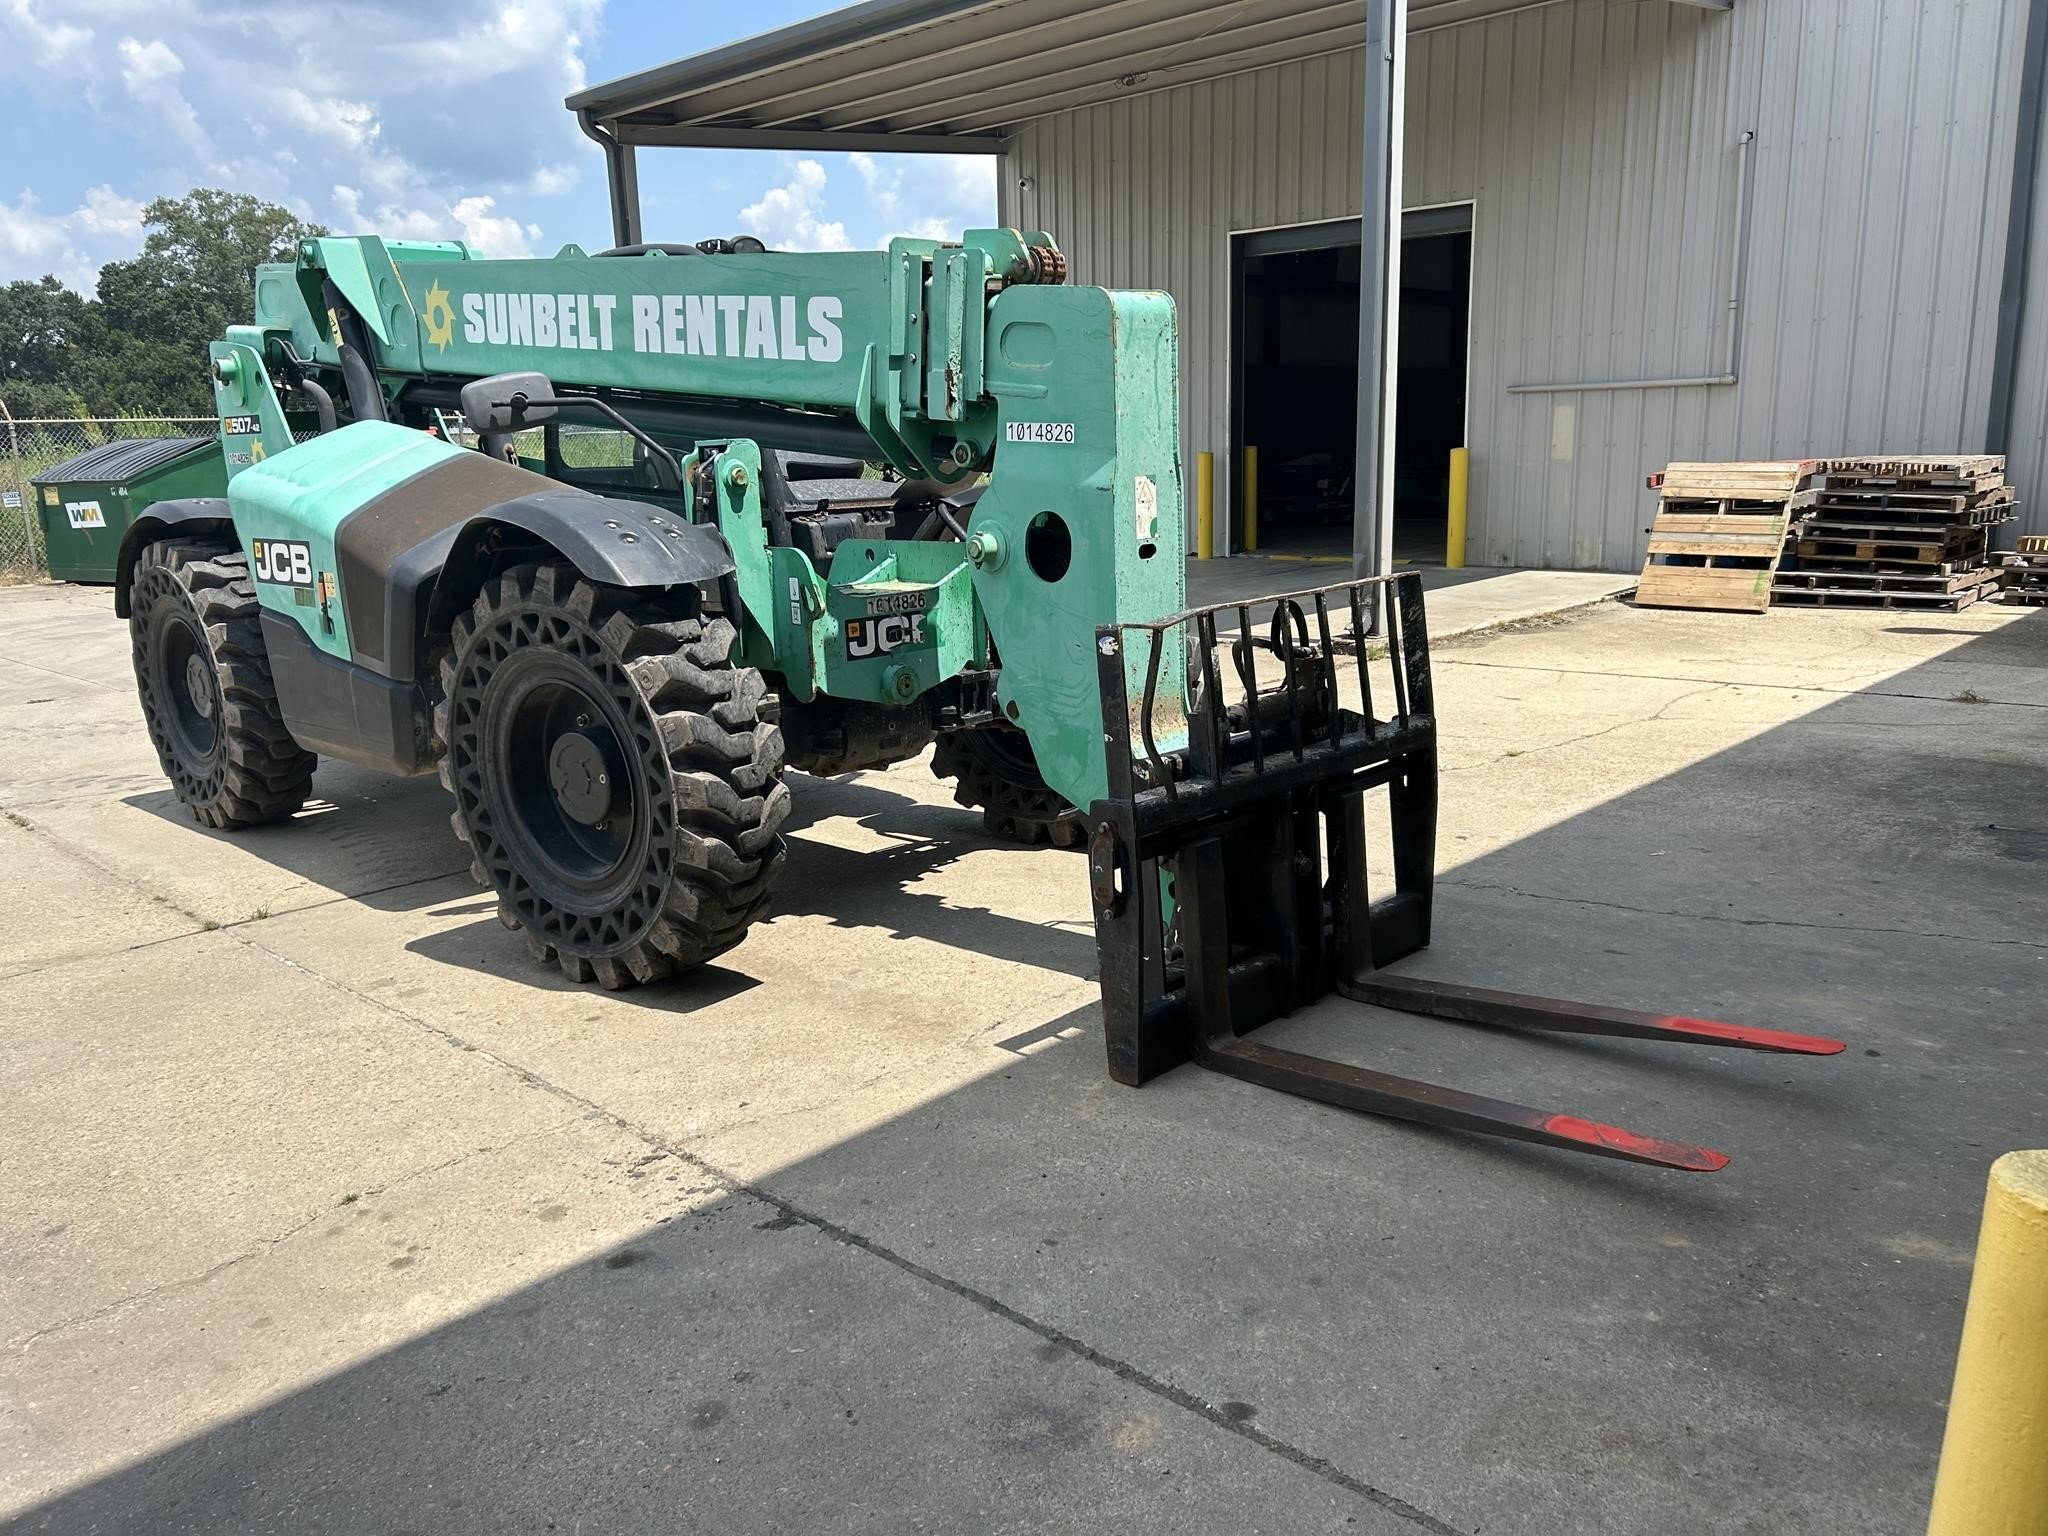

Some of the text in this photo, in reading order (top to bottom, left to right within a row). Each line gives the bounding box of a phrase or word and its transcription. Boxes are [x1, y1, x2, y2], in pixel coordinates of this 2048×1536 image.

[462, 293, 843, 362] SUNBELT RENTALS
[1007, 423, 1073, 442] 1014826
[71, 508, 100, 522] WM
[256, 542, 312, 584] JCB
